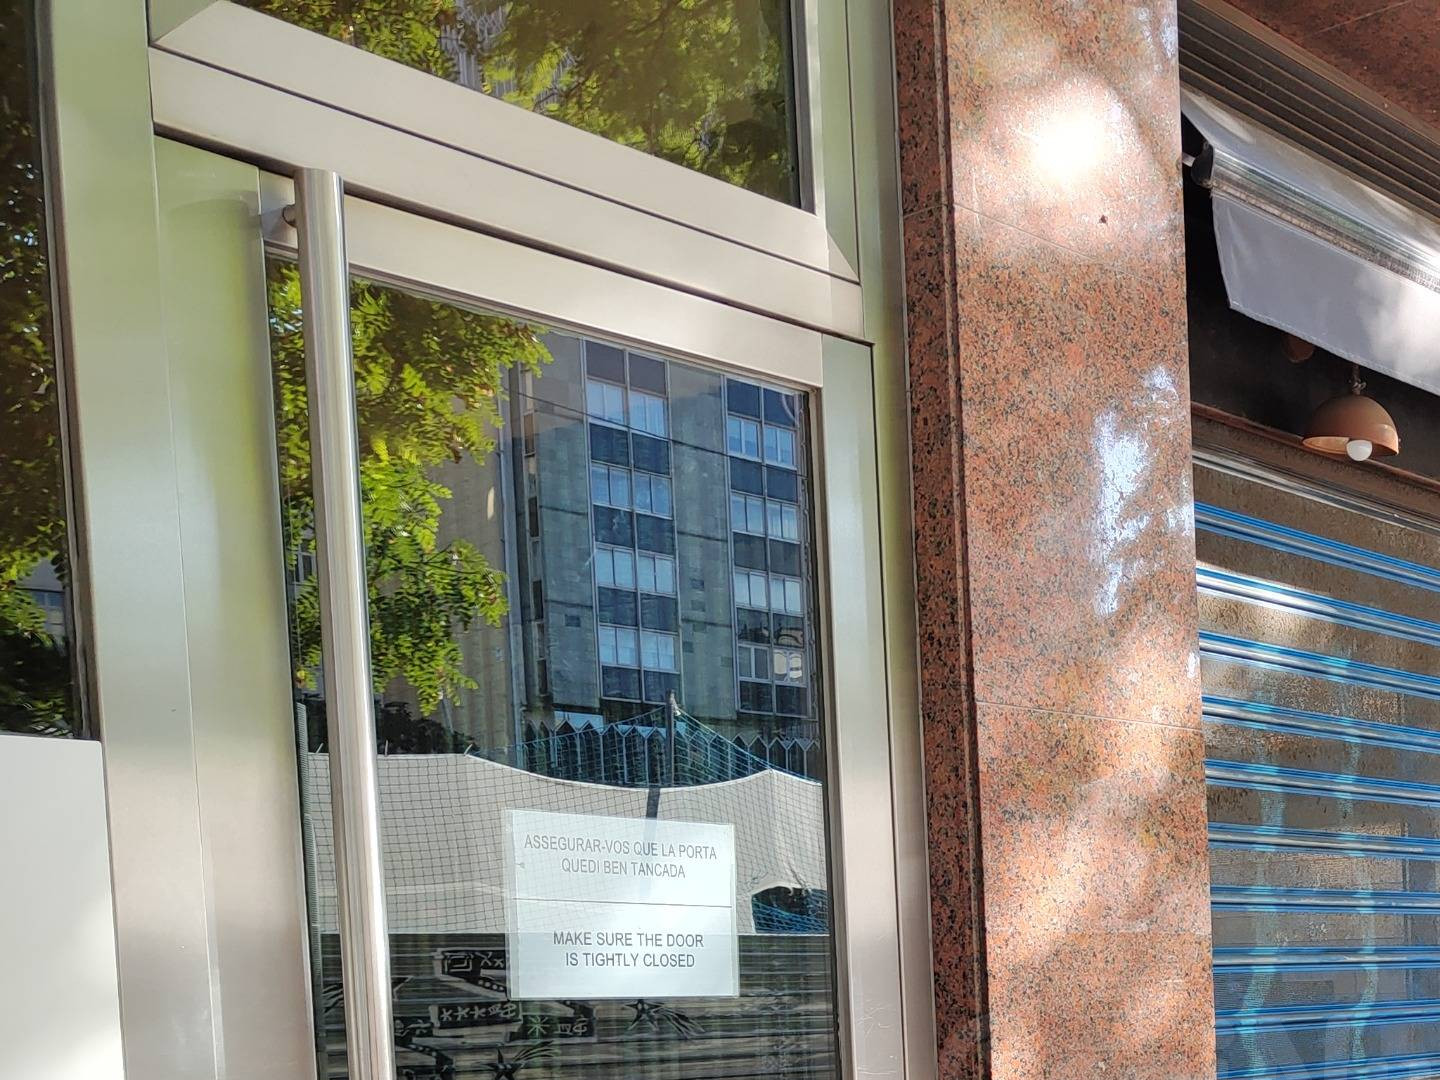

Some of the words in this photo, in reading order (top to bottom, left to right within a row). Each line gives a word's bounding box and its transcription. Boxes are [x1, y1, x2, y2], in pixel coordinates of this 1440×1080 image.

[524, 834, 630, 855] ASSEGURAR-VOS
[633, 841, 658, 857] QUE
[661, 844, 676, 858] LA
[678, 845, 717, 860] PORTA
[561, 858, 600, 874] QUEDI
[603, 860, 628, 875] BEN
[631, 861, 686, 878] TANCADA
[553, 931, 592, 946] MAKE
[596, 932, 633, 947] SURE
[637, 933, 663, 947] THE
[666, 934, 704, 948] DOOR
[565, 952, 579, 967] IS
[583, 953, 639, 967] TIGHTLY
[643, 953, 695, 968] CLOSED
